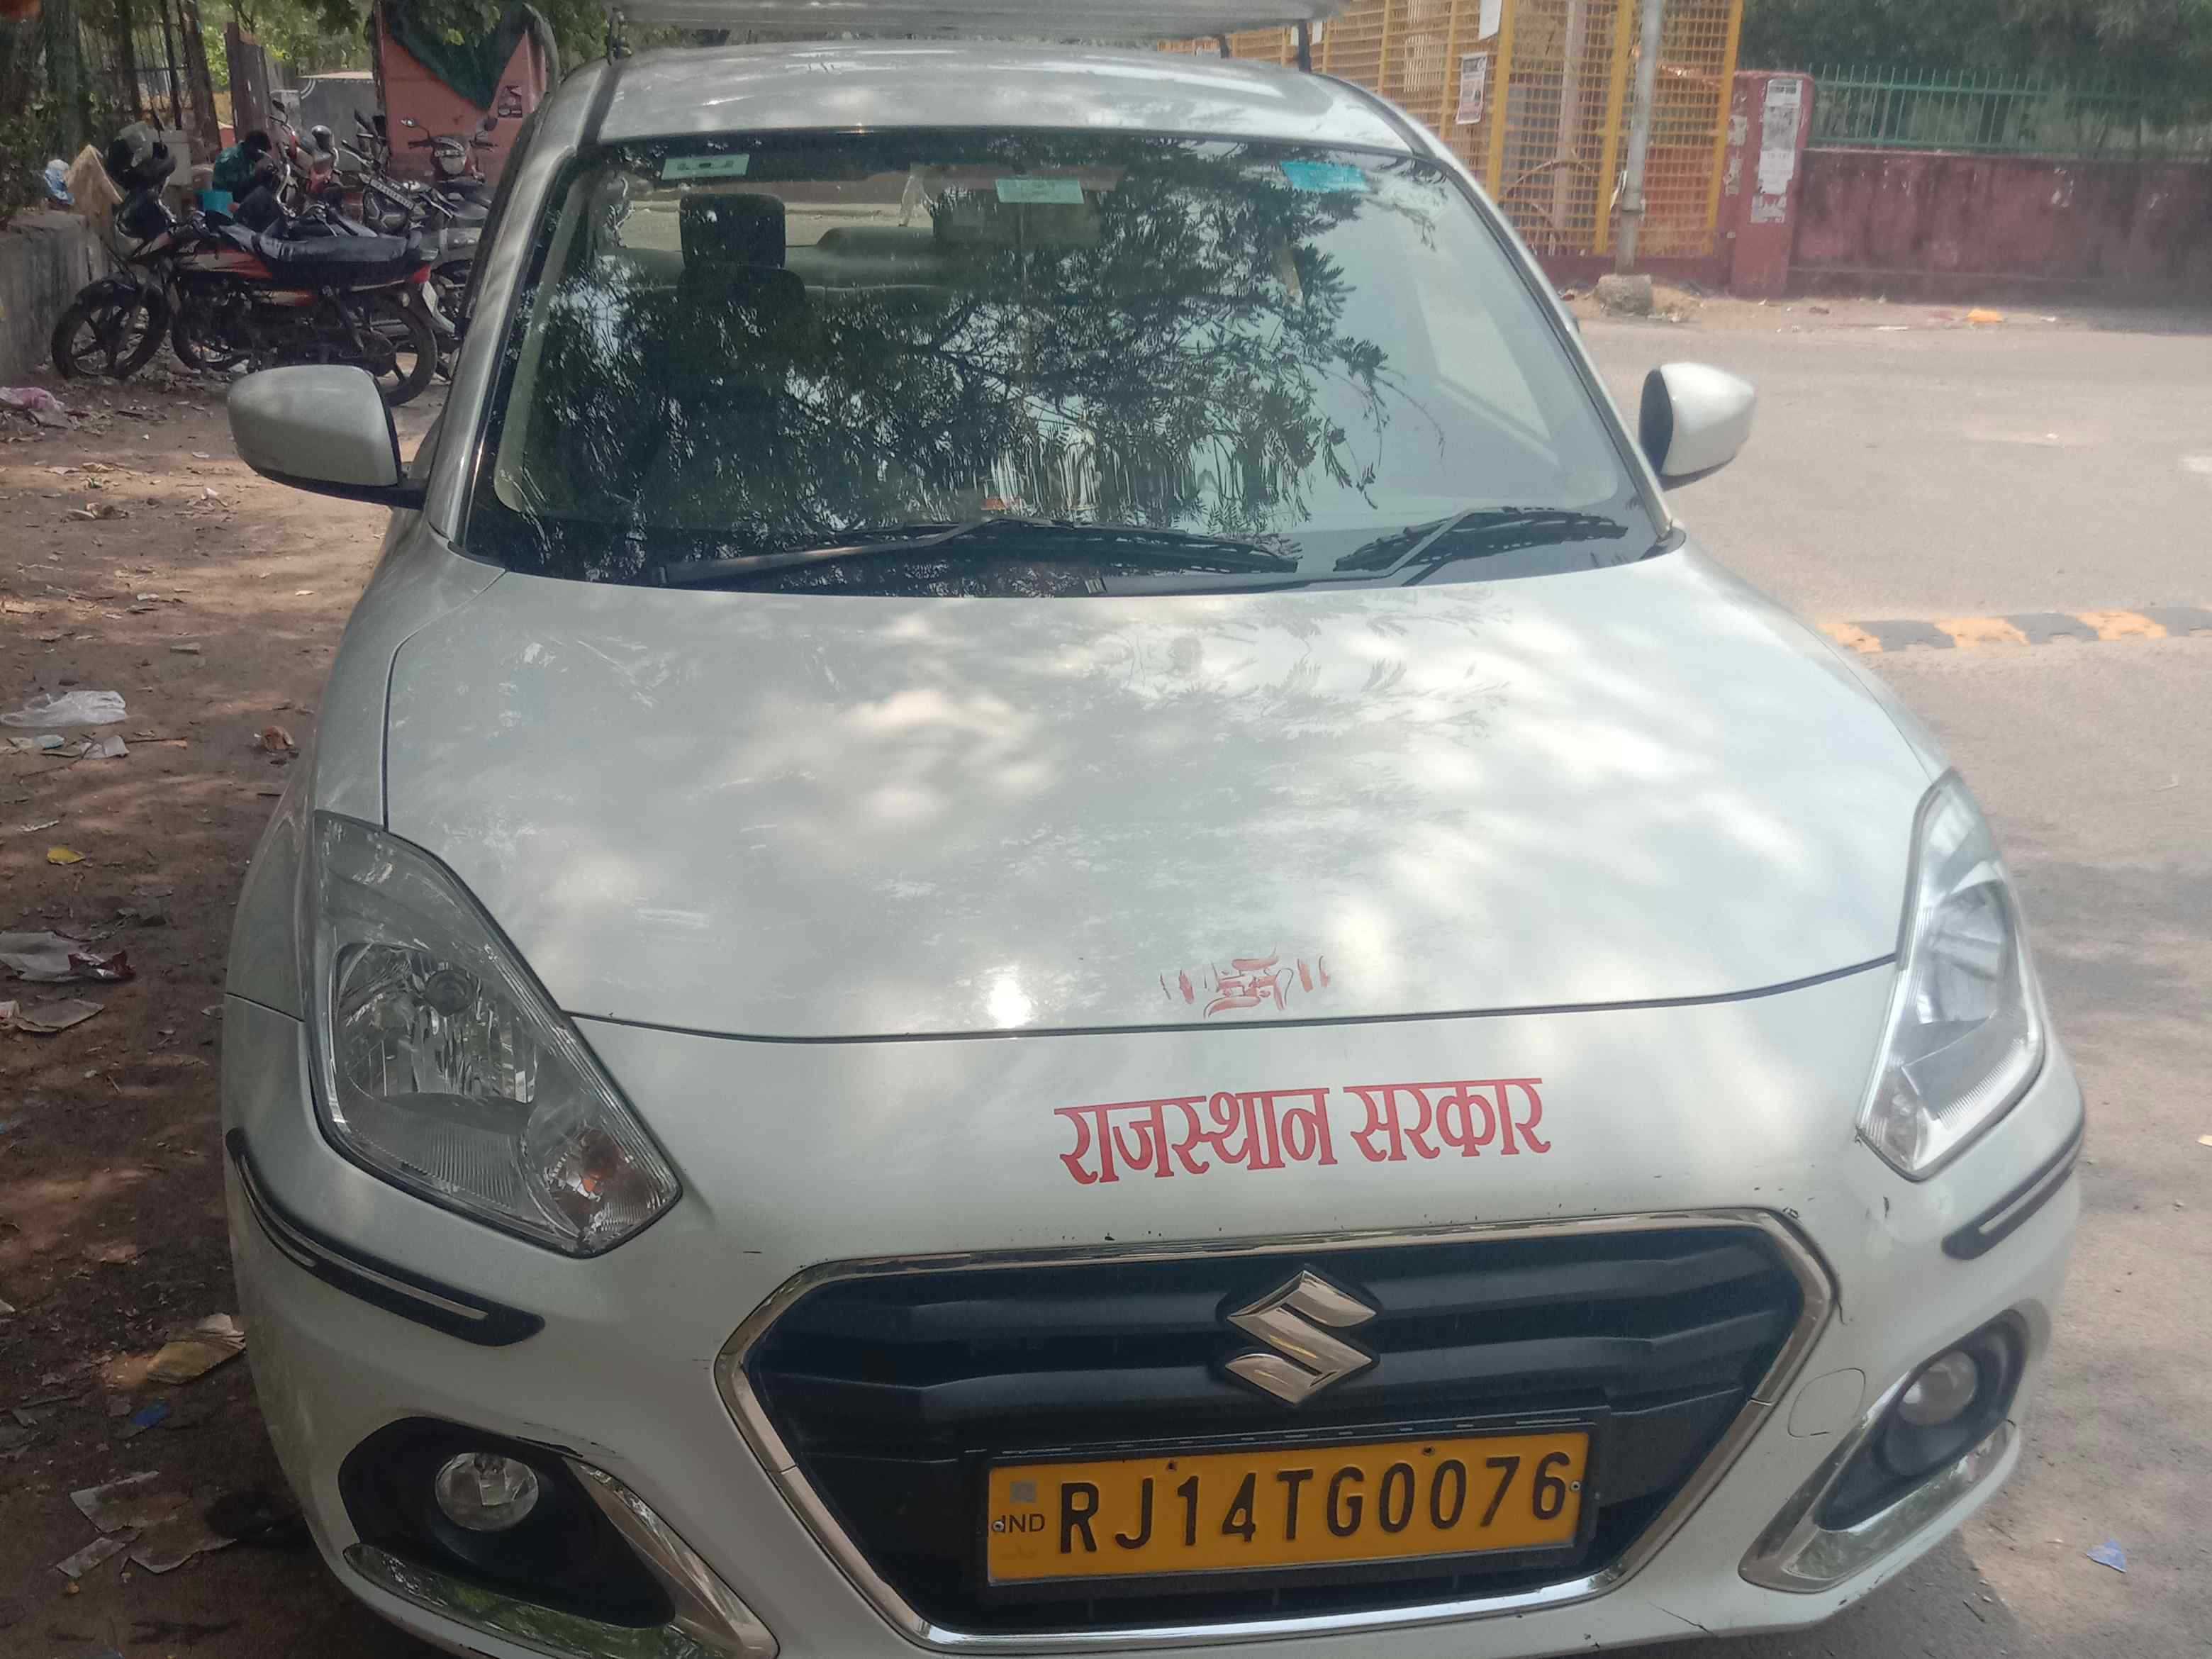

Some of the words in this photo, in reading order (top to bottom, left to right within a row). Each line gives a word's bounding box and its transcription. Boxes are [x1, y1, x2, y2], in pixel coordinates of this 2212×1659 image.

[1054, 1088, 1338, 1185] राजस्थान
[1344, 1078, 1551, 1162] सरकार
[1060, 1451, 1570, 1555] RJ14TG0076
